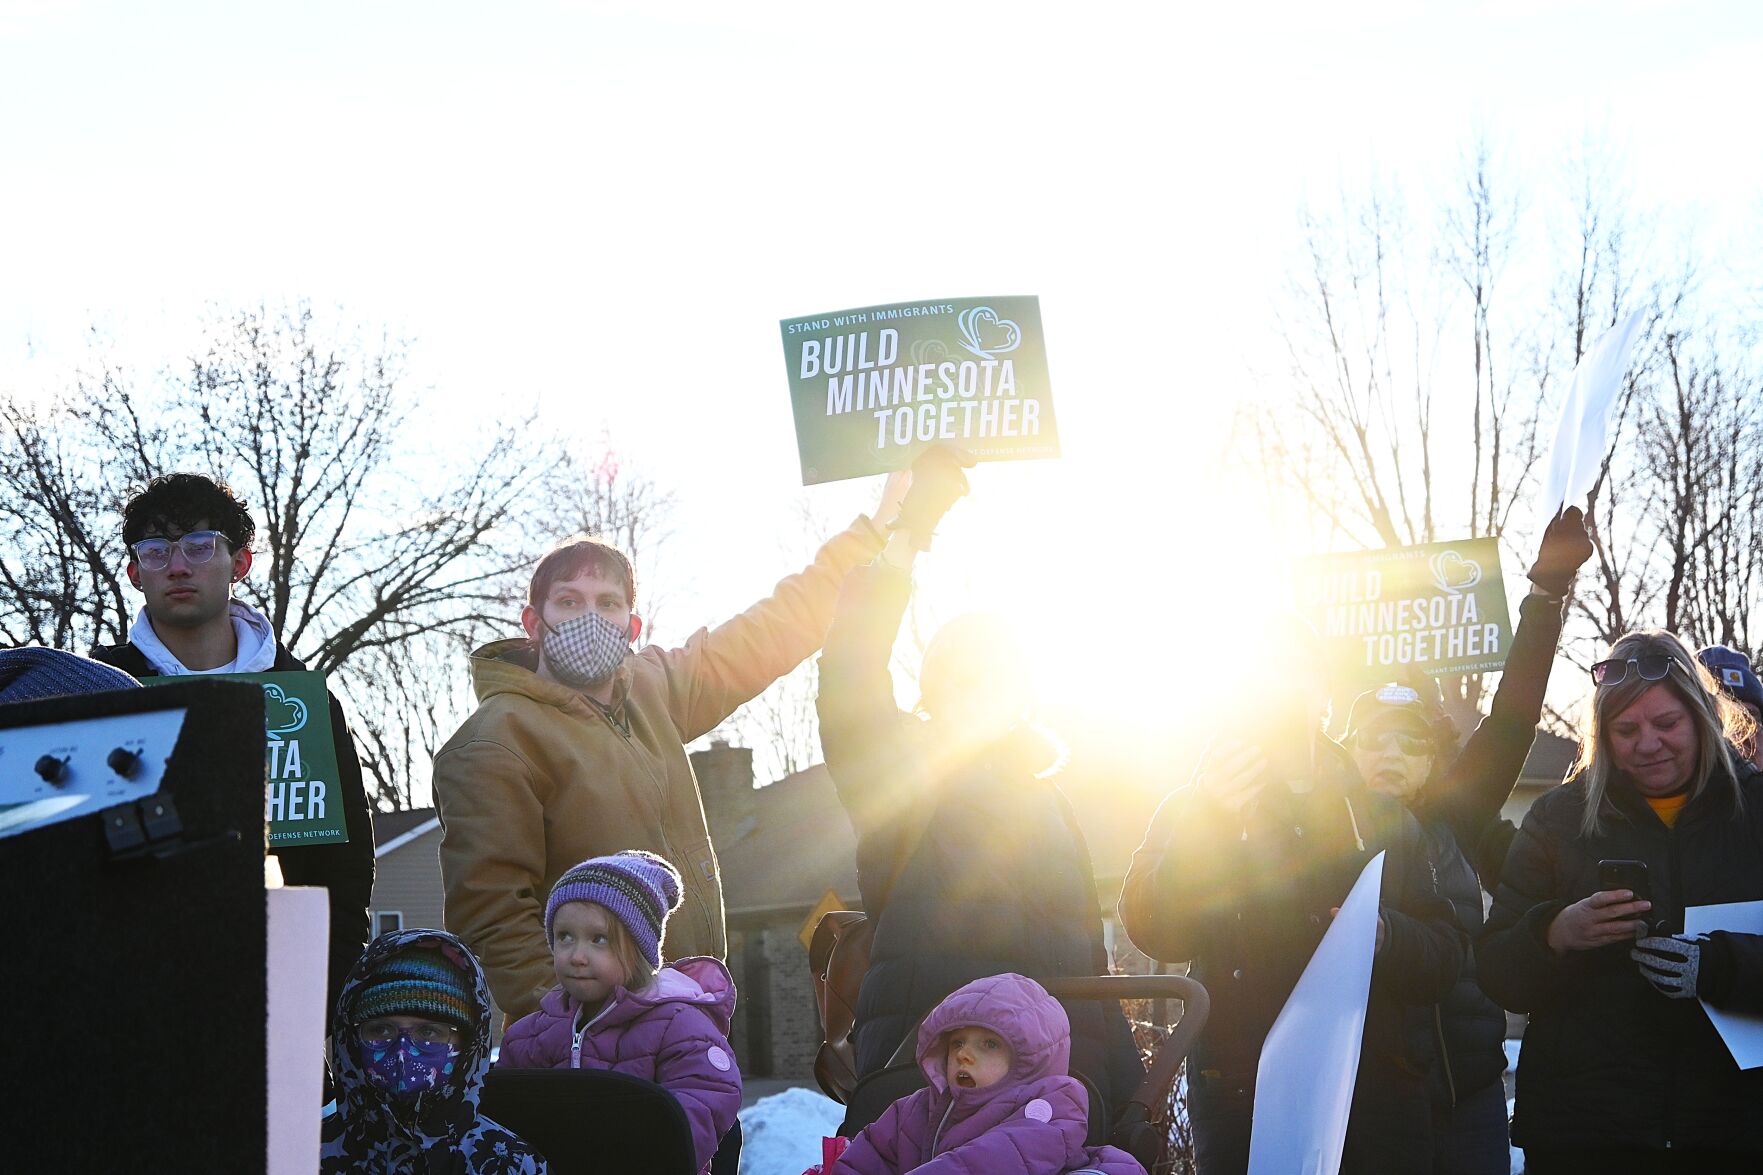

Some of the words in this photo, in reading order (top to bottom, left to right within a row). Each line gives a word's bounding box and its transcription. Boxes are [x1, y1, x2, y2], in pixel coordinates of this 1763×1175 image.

[788, 319, 830, 334] STAND
[834, 313, 867, 327] WITH
[871, 304, 954, 321] IMMIGRANTS
[801, 328, 898, 379] BUILD
[826, 359, 1016, 416] MINNESOTA
[874, 398, 1040, 449] TOGETHER
[1325, 592, 1478, 637] MINNESOTA
[1362, 623, 1500, 667] TOGETHER
[267, 739, 301, 779] TA
[268, 780, 326, 822] HER
[269, 831, 301, 840] DEFENSE
[303, 829, 340, 838] NETWORK
